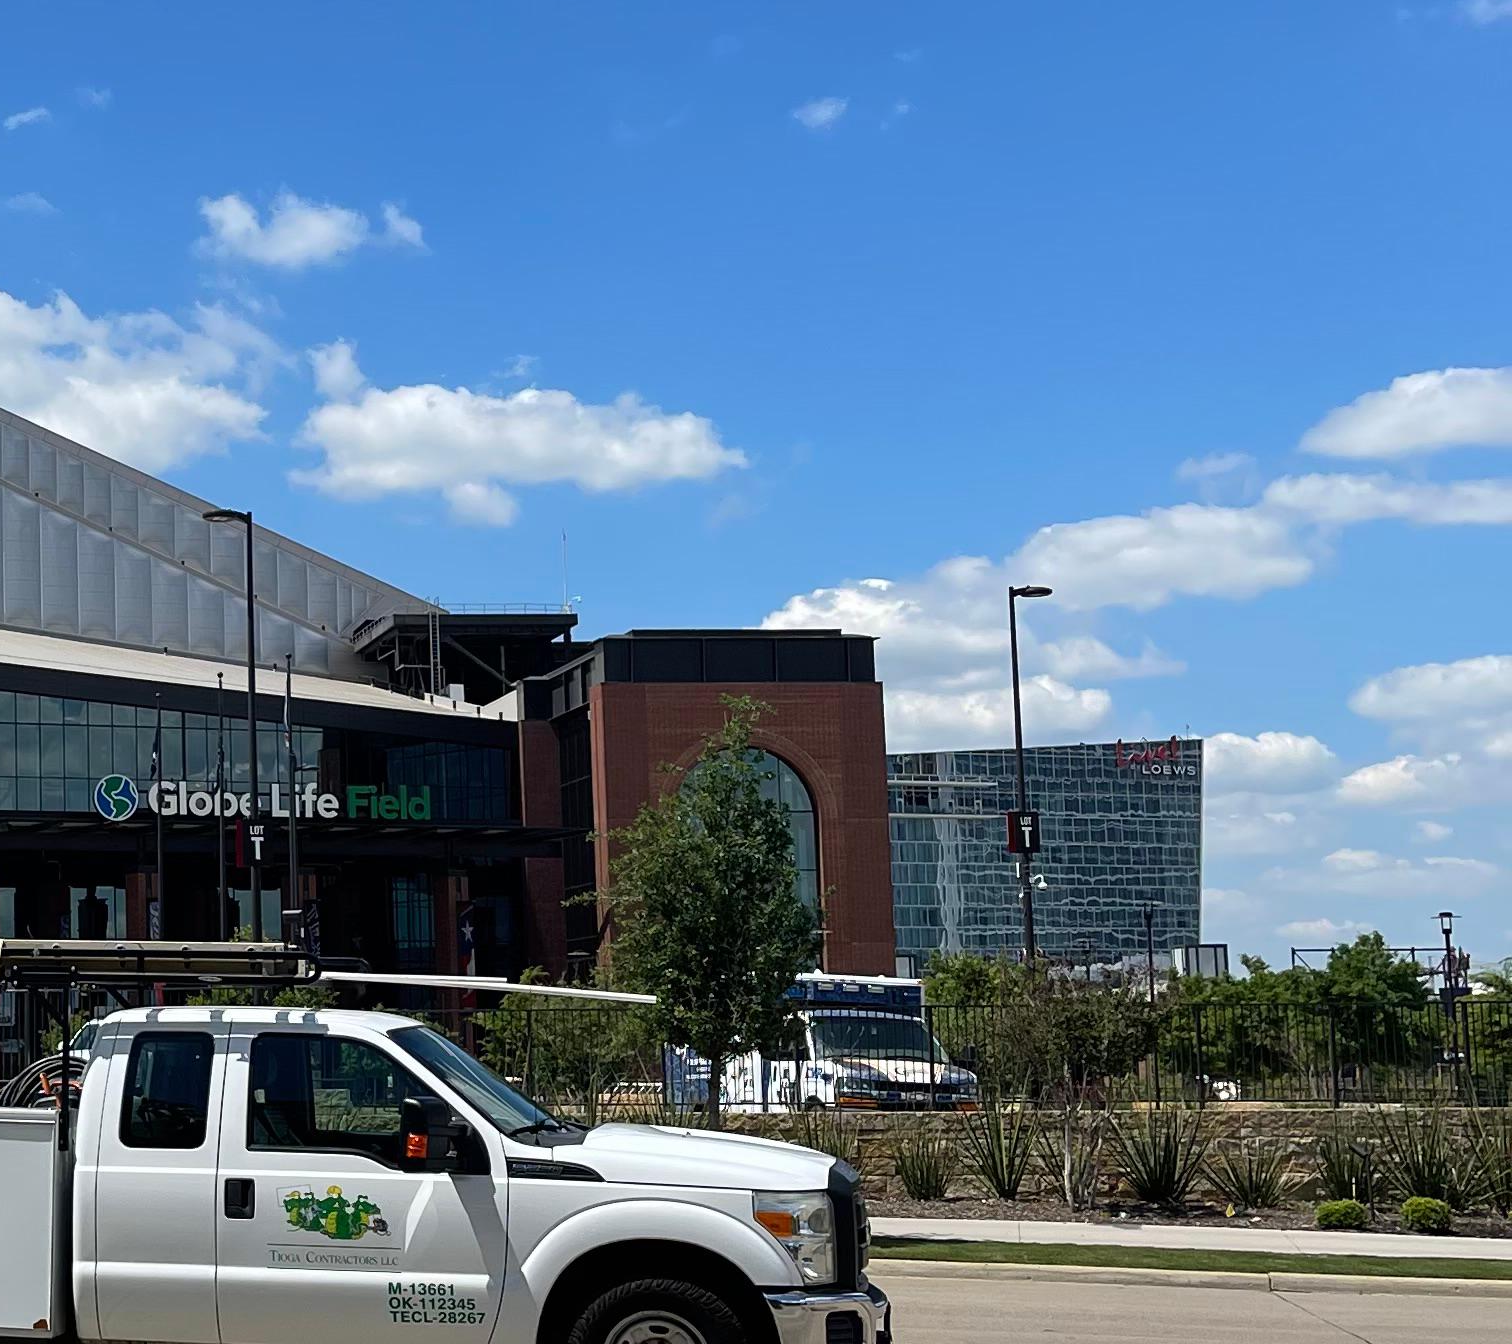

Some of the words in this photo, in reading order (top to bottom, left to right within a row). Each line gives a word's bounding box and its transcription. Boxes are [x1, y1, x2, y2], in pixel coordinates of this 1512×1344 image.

[1141, 764, 1196, 776] LOEWS
[148, 780, 262, 817] Globe
[271, 782, 339, 819] Life
[346, 784, 431, 820] Field
[249, 825, 265, 835] LOT
[1021, 826, 1032, 847] T
[250, 836, 264, 860] T
[388, 1282, 455, 1296] M-13661
[389, 1296, 476, 1311] OK-112345
[390, 1310, 486, 1324] TECL-28267
